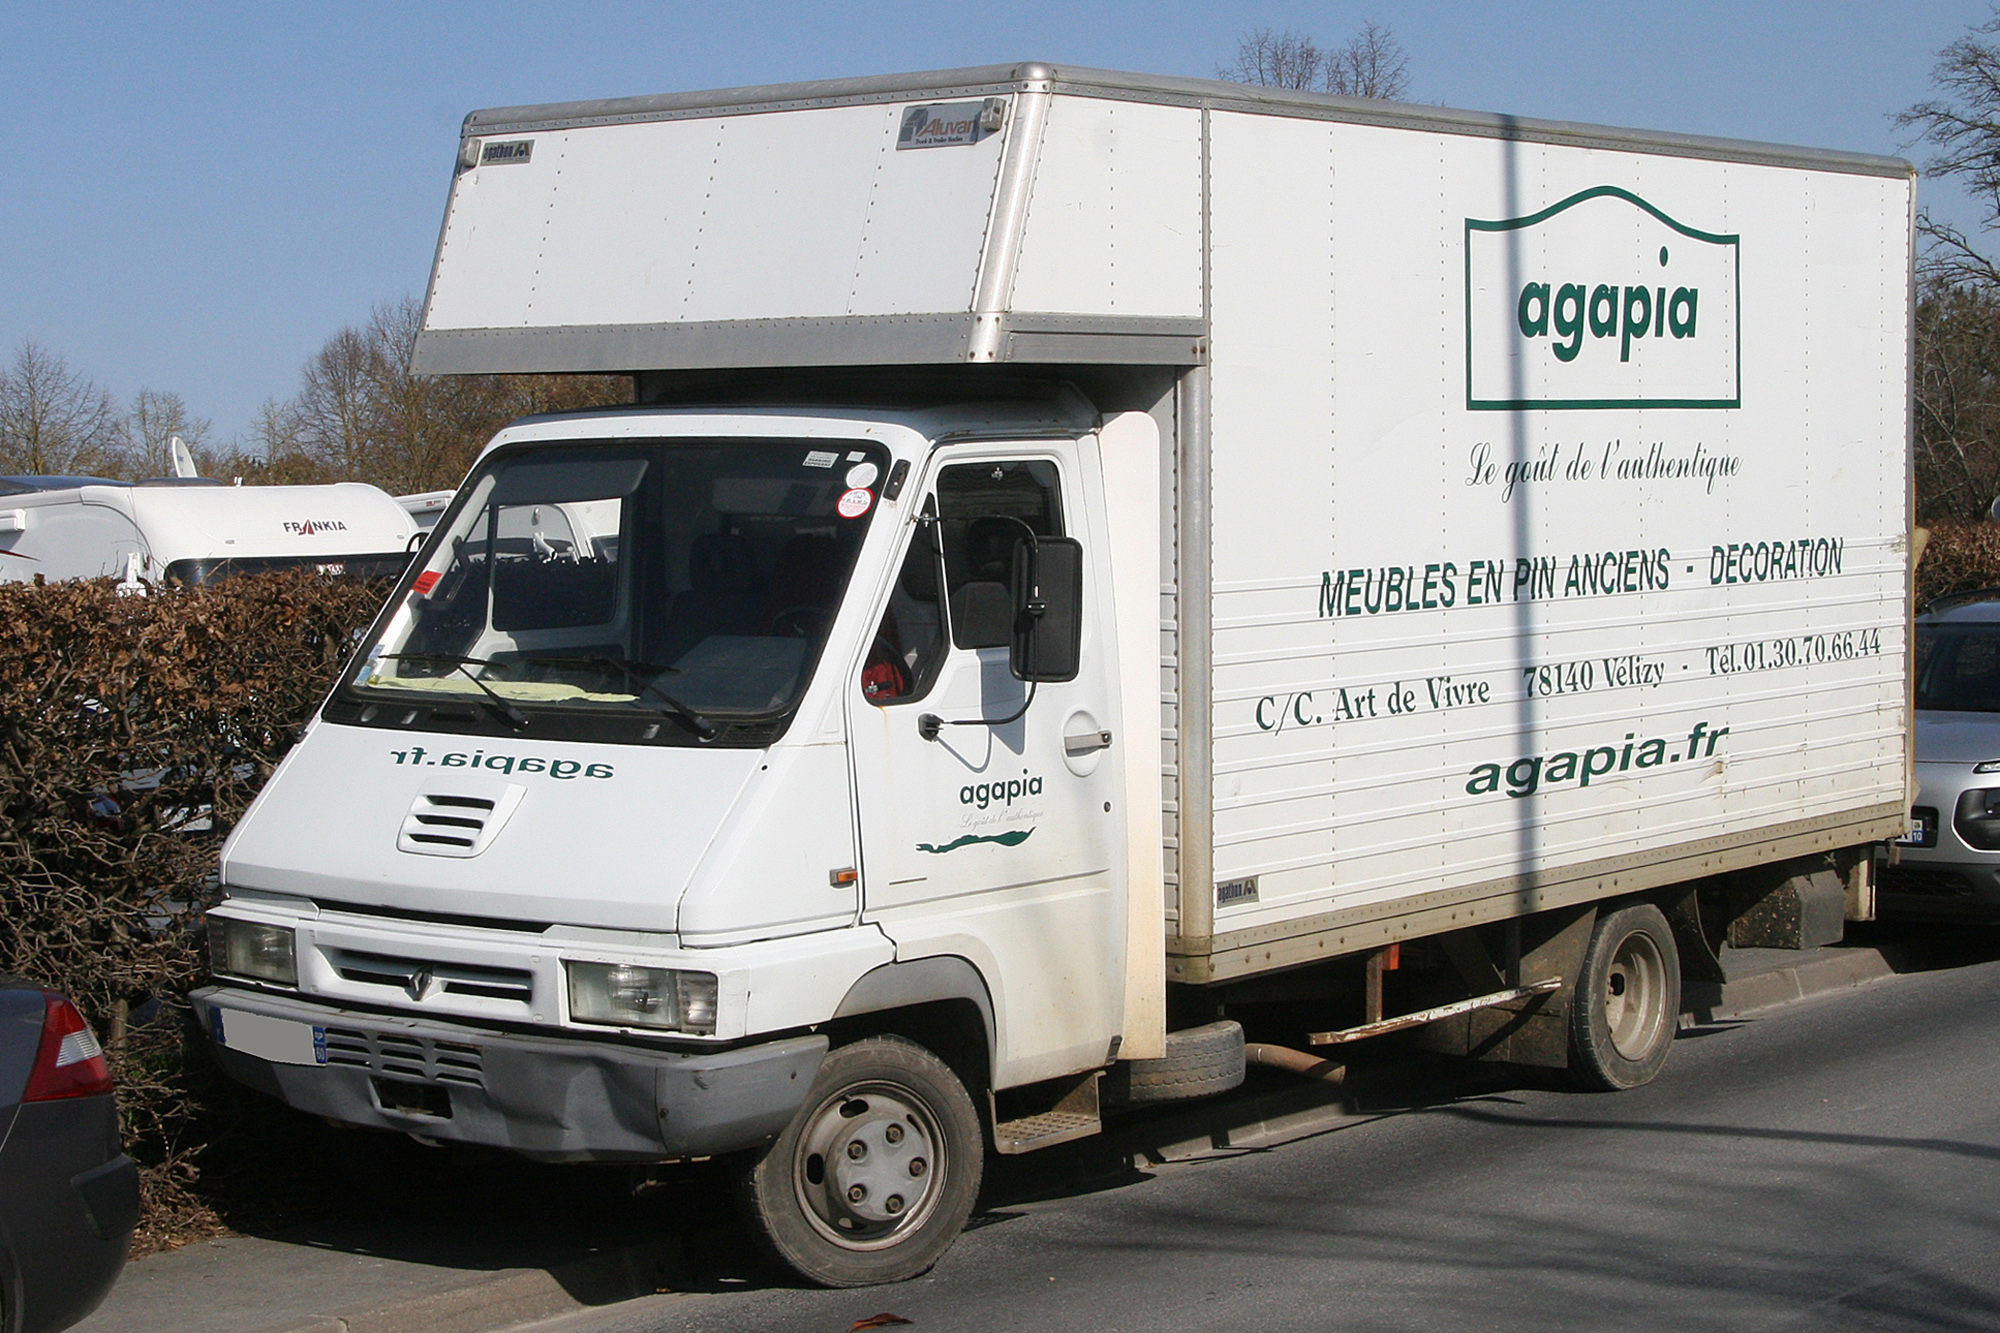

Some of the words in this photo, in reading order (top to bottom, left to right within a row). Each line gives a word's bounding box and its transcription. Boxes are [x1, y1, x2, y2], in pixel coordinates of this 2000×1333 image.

[1518, 246, 1698, 362] agapia
[1465, 442, 1500, 486] Le
[1501, 443, 1560, 503] goût
[1566, 442, 1594, 481] de
[1600, 439, 1743, 495] l'authentique
[283, 519, 347, 535] FRANKIA
[1319, 562, 1457, 617] MEUBLES
[1467, 559, 1504, 604] EN
[1514, 556, 1556, 601] PIN
[1564, 548, 1670, 597] ANCIENS
[1710, 537, 1843, 585] DECORATION
[1255, 691, 1322, 736] C/C.
[1334, 687, 1378, 721] Art
[1387, 681, 1416, 715] de
[1425, 676, 1490, 708] Vivre
[1523, 661, 1594, 697] 78140
[1602, 655, 1664, 688] Vélizy
[960, 768, 1042, 809] agapia
[1465, 722, 1730, 798] agapia.fr
[1913, 831, 1923, 841] 10
